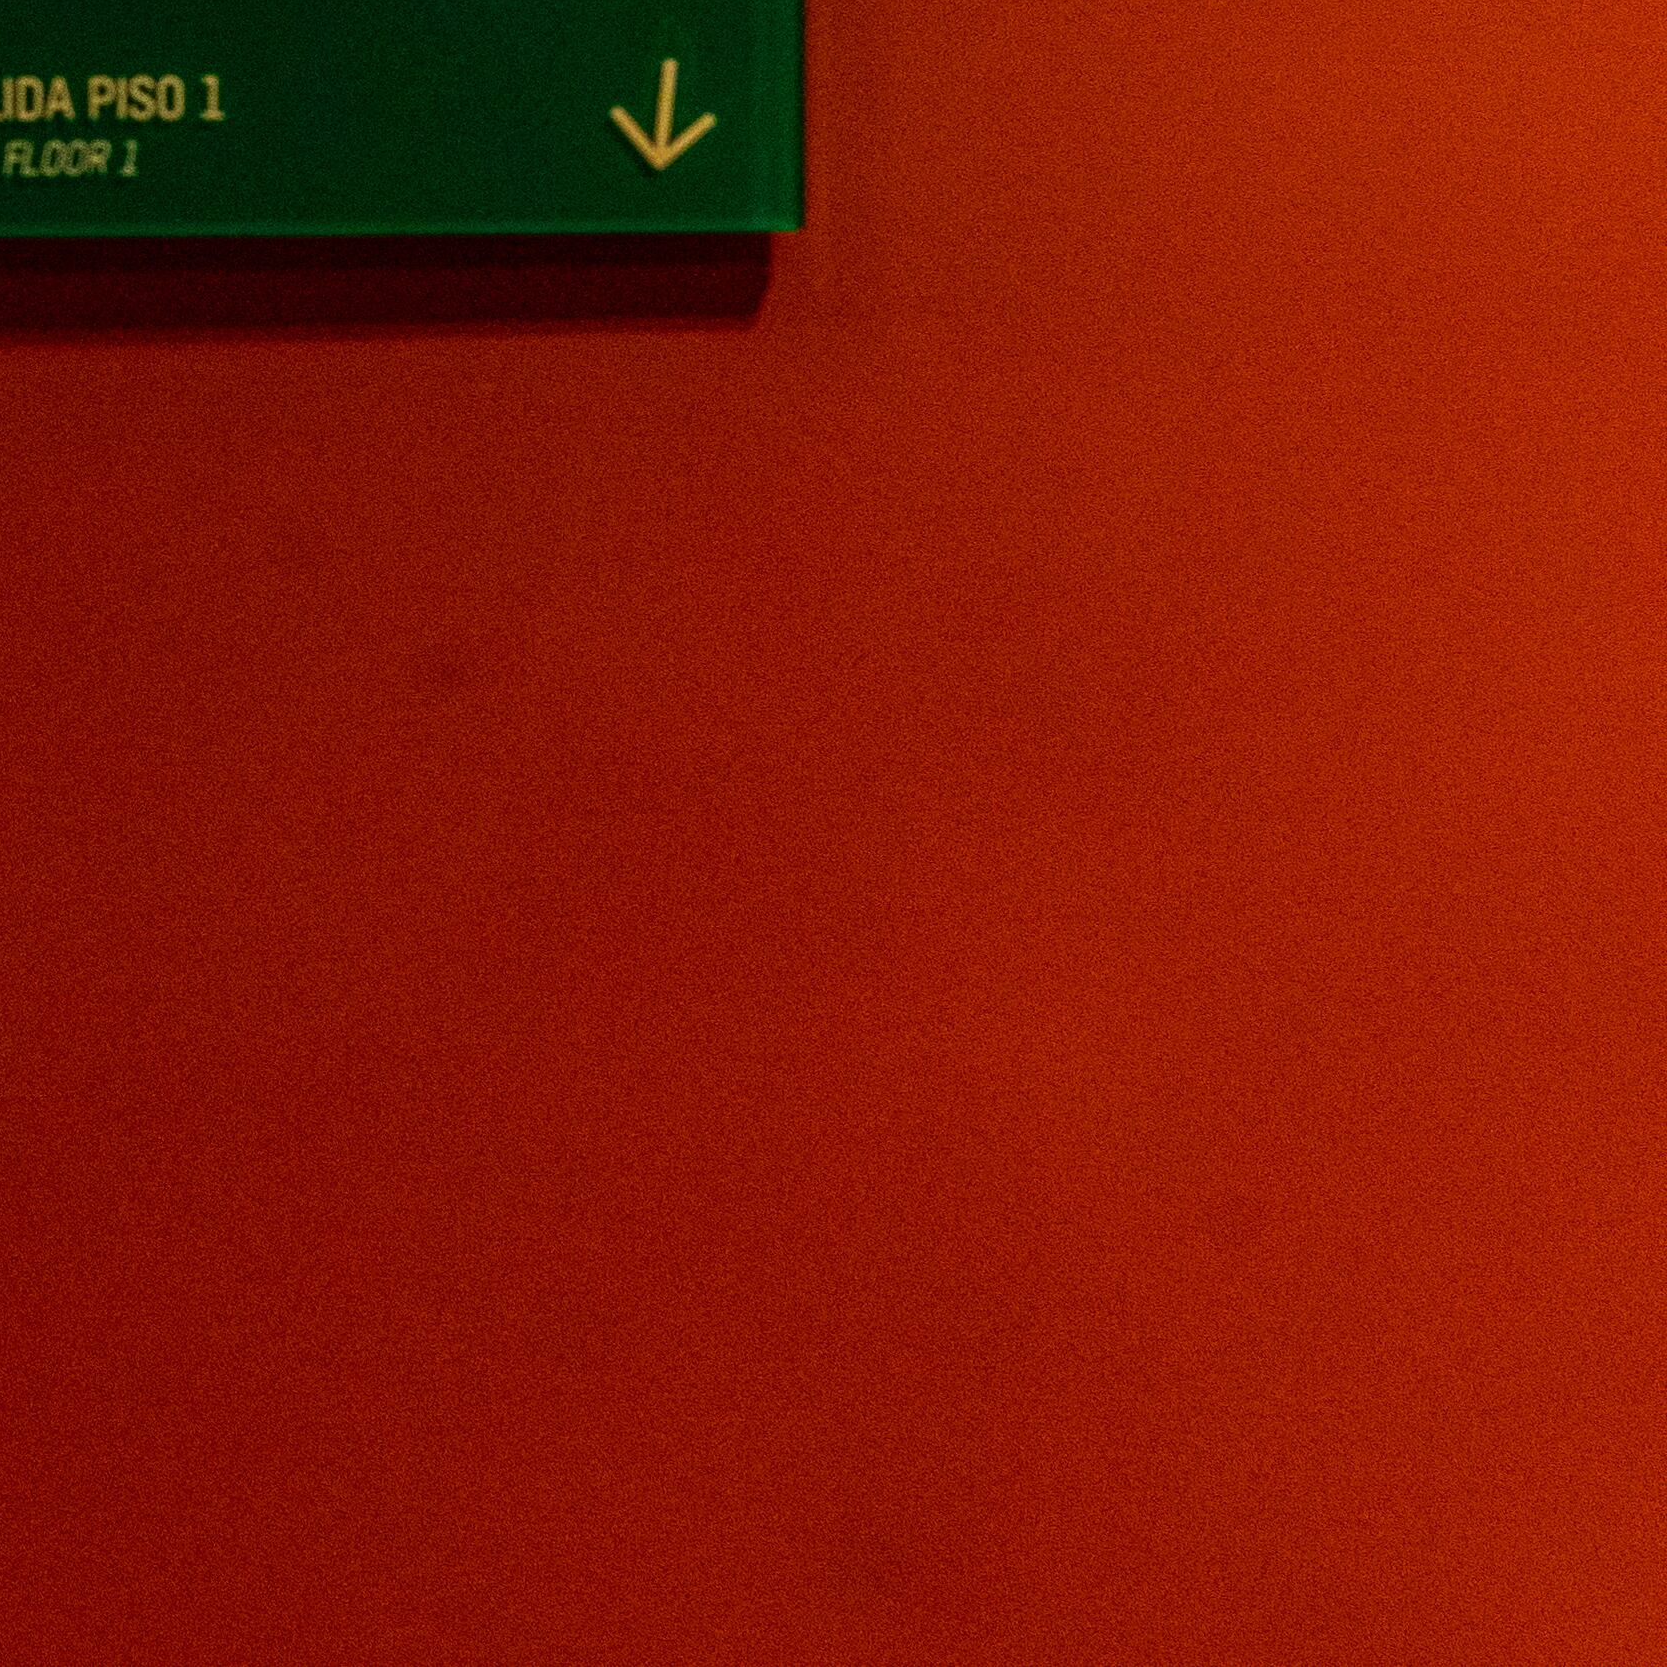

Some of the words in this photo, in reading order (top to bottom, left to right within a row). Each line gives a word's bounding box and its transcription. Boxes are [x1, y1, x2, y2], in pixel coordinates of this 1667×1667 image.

[87, 74, 185, 121] PISO
[201, 75, 224, 121] 1
[3, 139, 111, 176] FLOOR
[120, 140, 137, 177] 1
